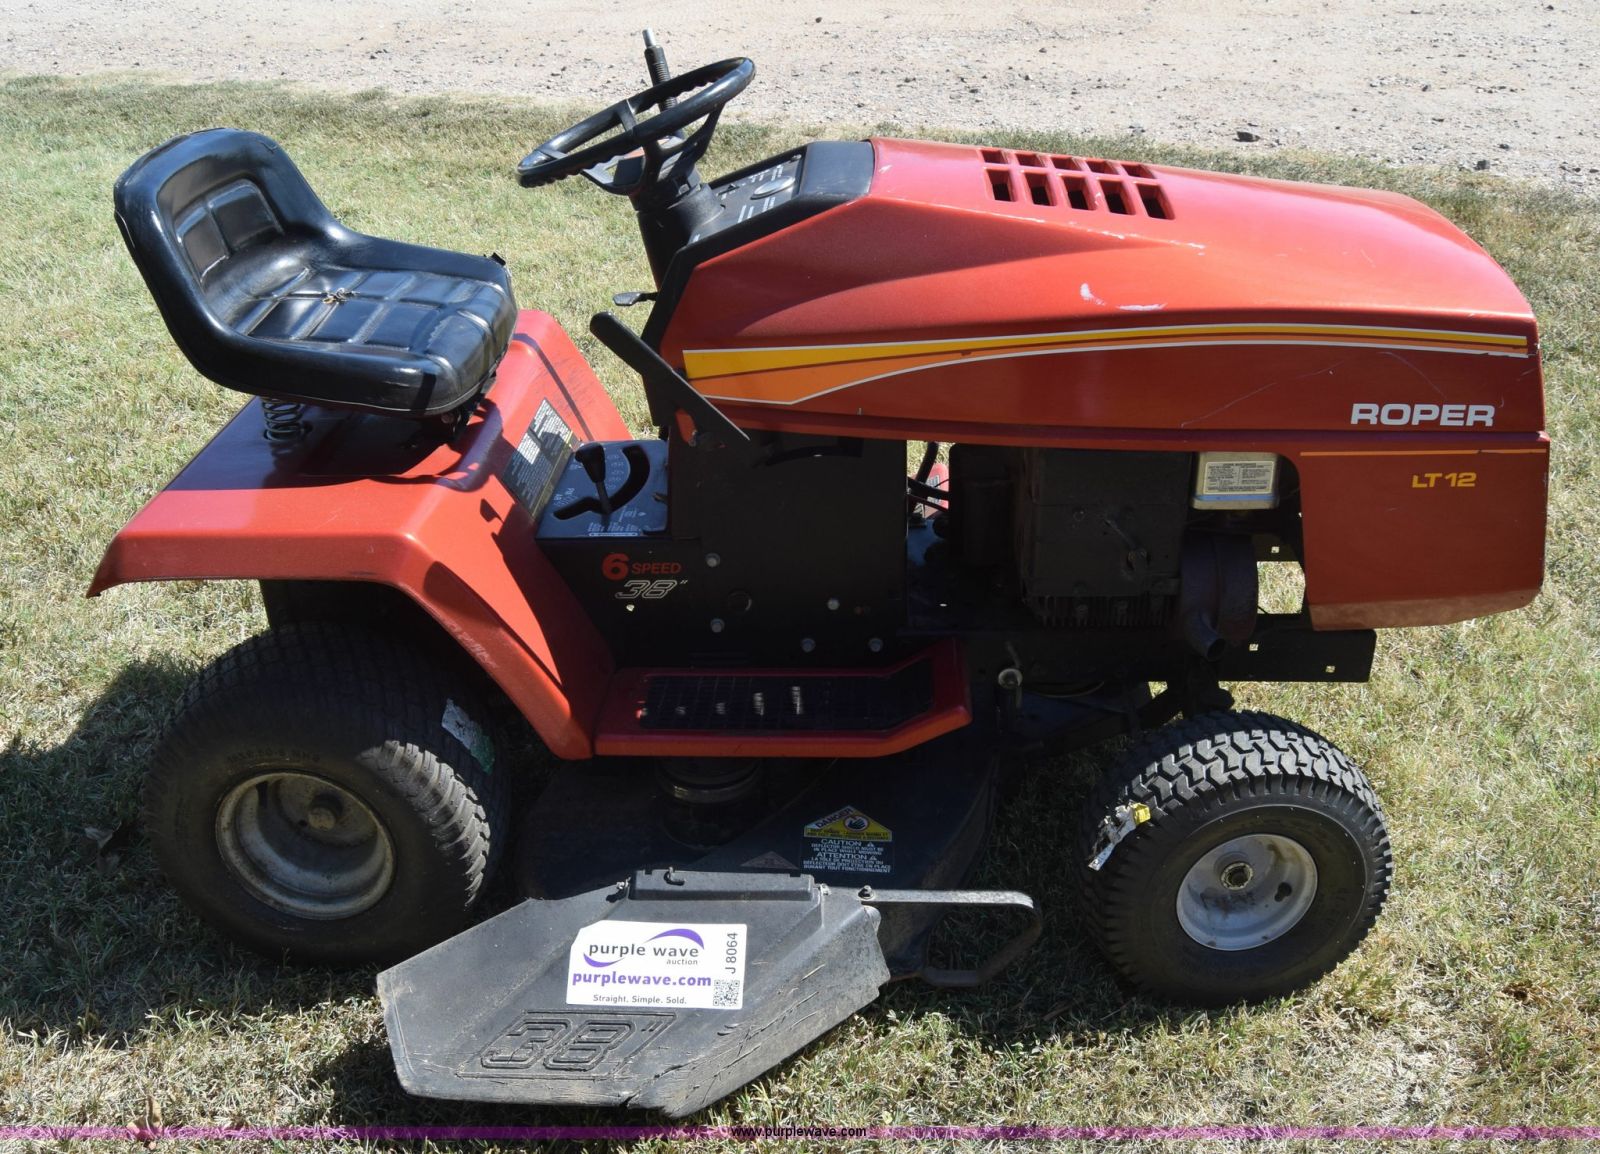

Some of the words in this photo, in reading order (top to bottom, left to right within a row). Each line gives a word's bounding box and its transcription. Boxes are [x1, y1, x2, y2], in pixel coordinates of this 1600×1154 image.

[1350, 403, 1495, 427] ROPER
[602, 553, 629, 580] 6
[632, 562, 682, 574] SPEED
[615, 580, 688, 599] 38"
[815, 808, 854, 828] DANGER
[816, 852, 867, 860] ATTENTION
[589, 943, 646, 957] purple
[652, 947, 699, 957] wave
[726, 932, 738, 963] 8064
[666, 958, 698, 966] auction
[572, 971, 712, 987] purplewave.com
[593, 994, 629, 1004] Straight.
[631, 994, 663, 1004] Simple.
[666, 996, 687, 1004] Sold.
